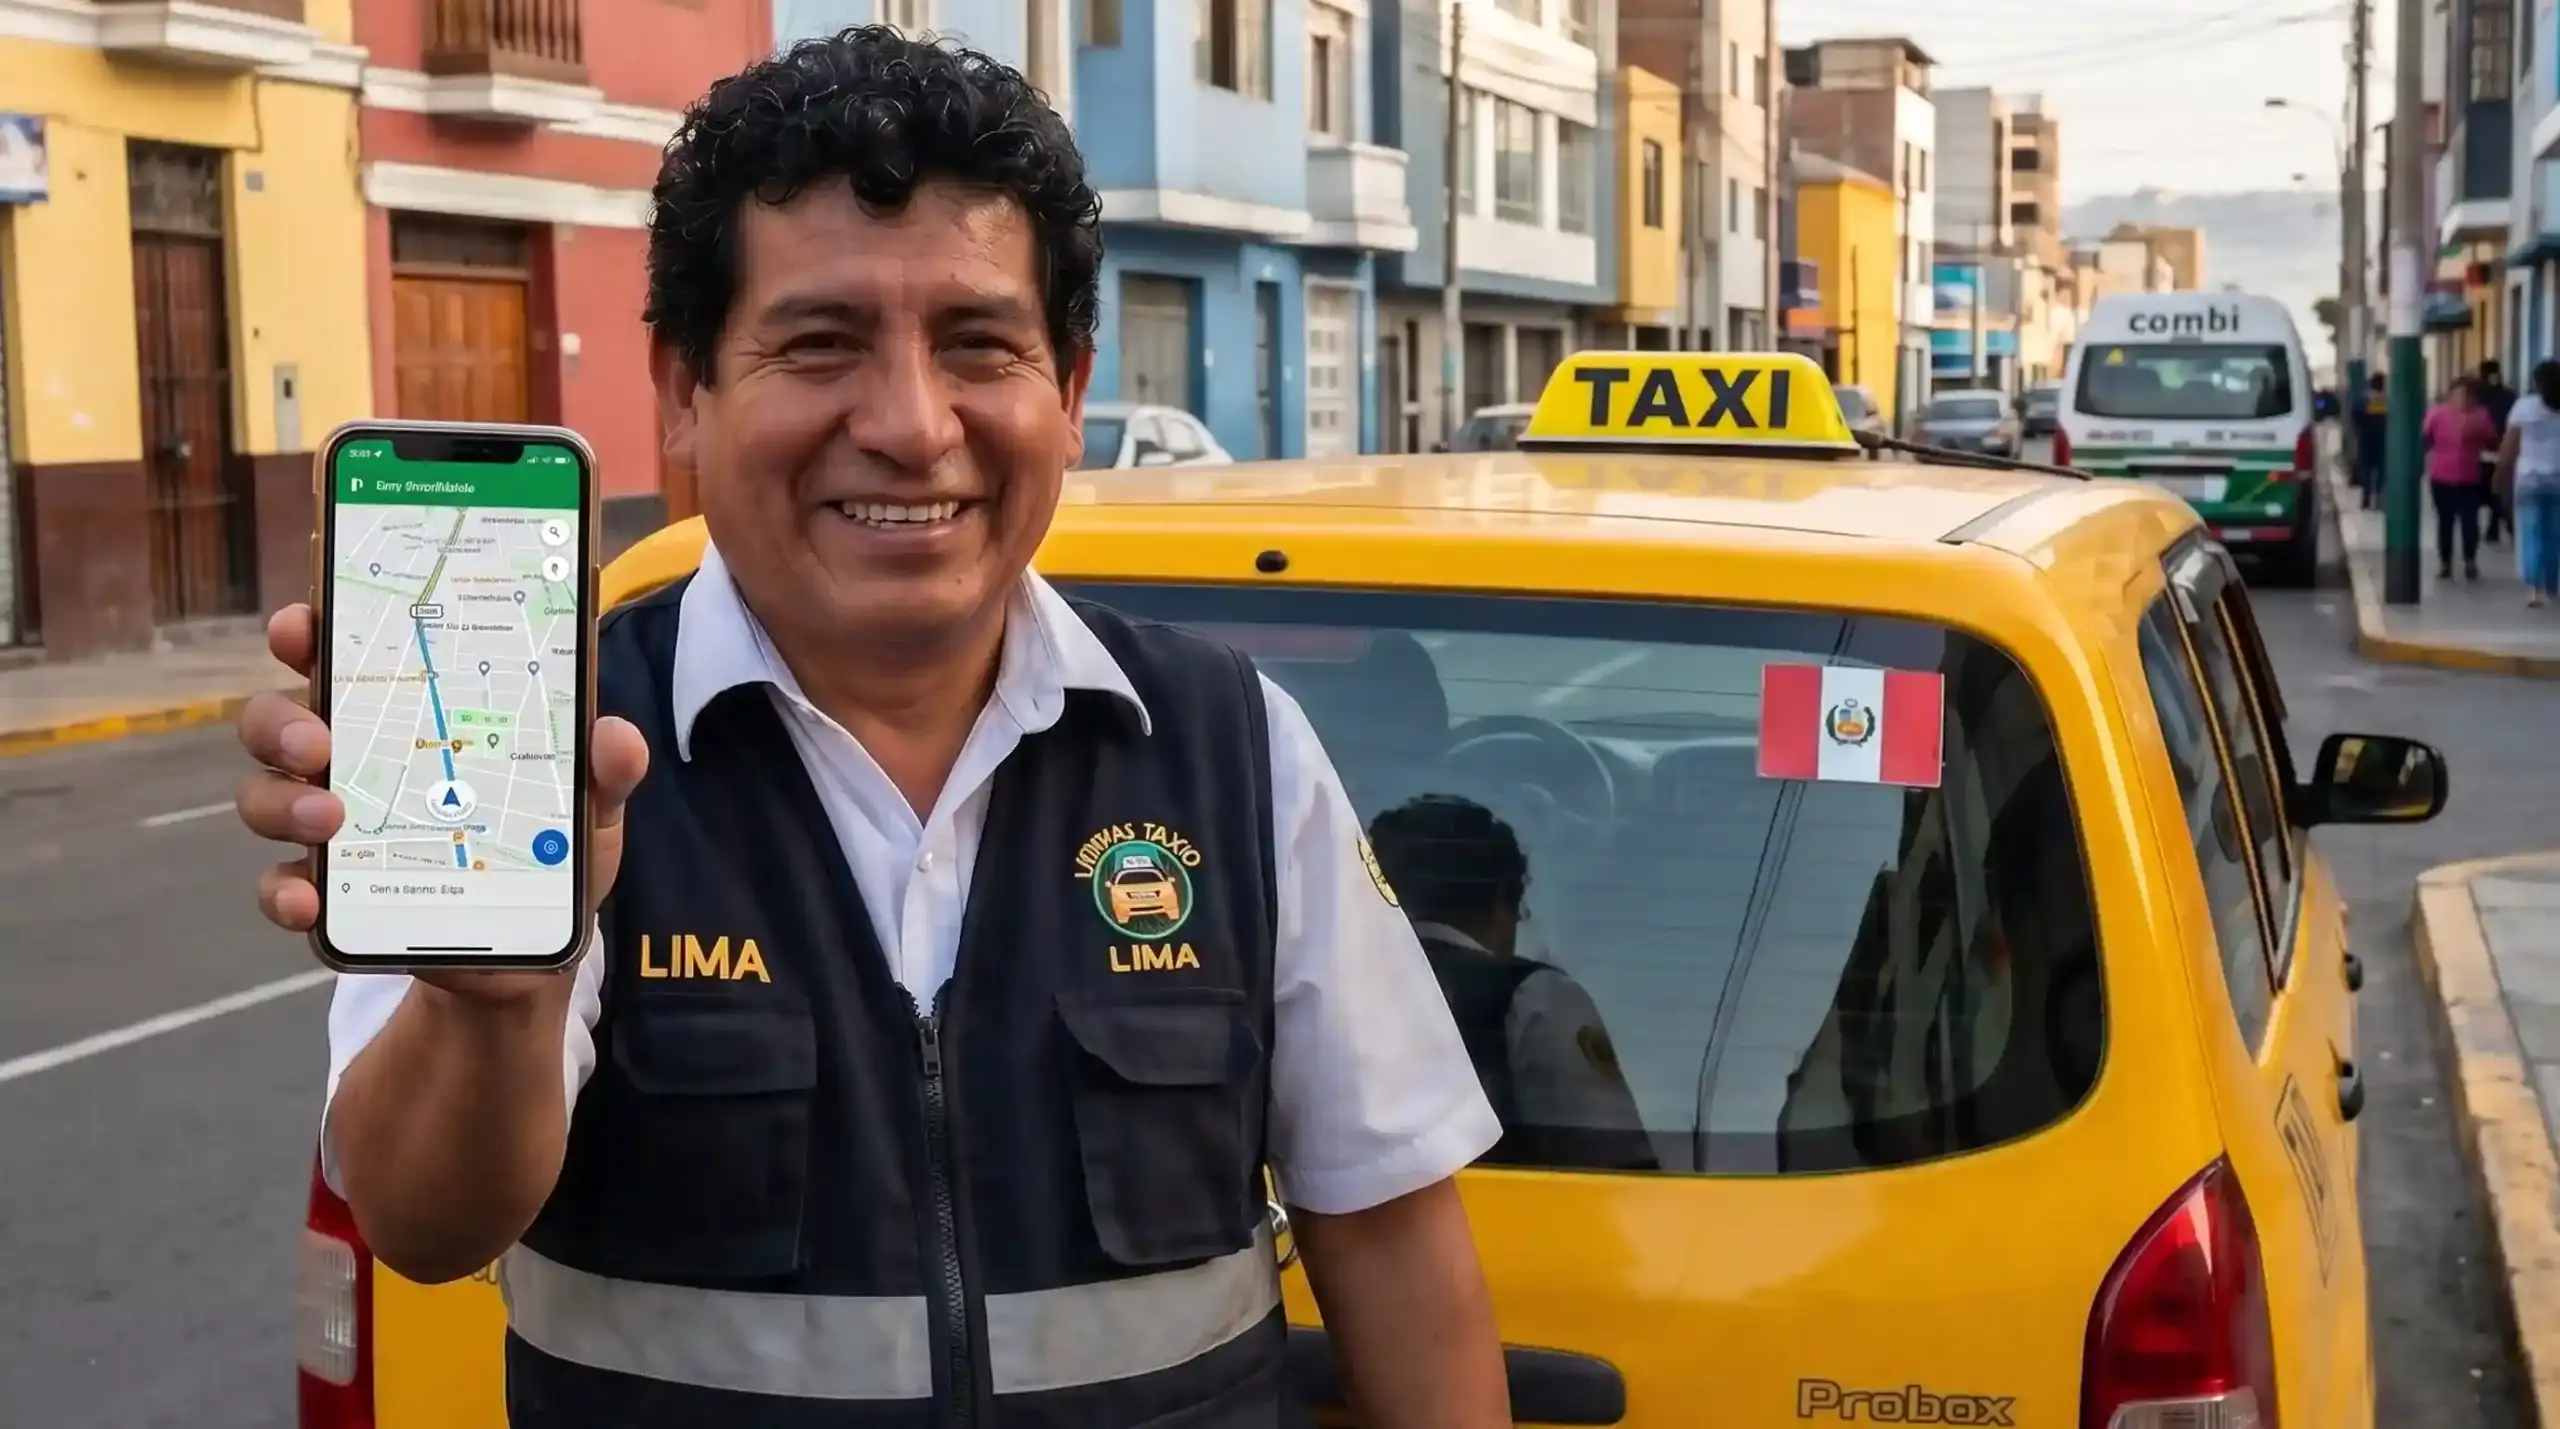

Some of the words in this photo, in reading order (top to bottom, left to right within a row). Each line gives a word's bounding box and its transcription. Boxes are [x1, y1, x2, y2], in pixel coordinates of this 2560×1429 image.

[2128, 304, 2241, 334] combi
[1574, 367, 1791, 429] TAXI
[640, 934, 771, 983] LIMA
[1109, 943, 1201, 973] LIMA
[1797, 1378, 2016, 1427] Probox
